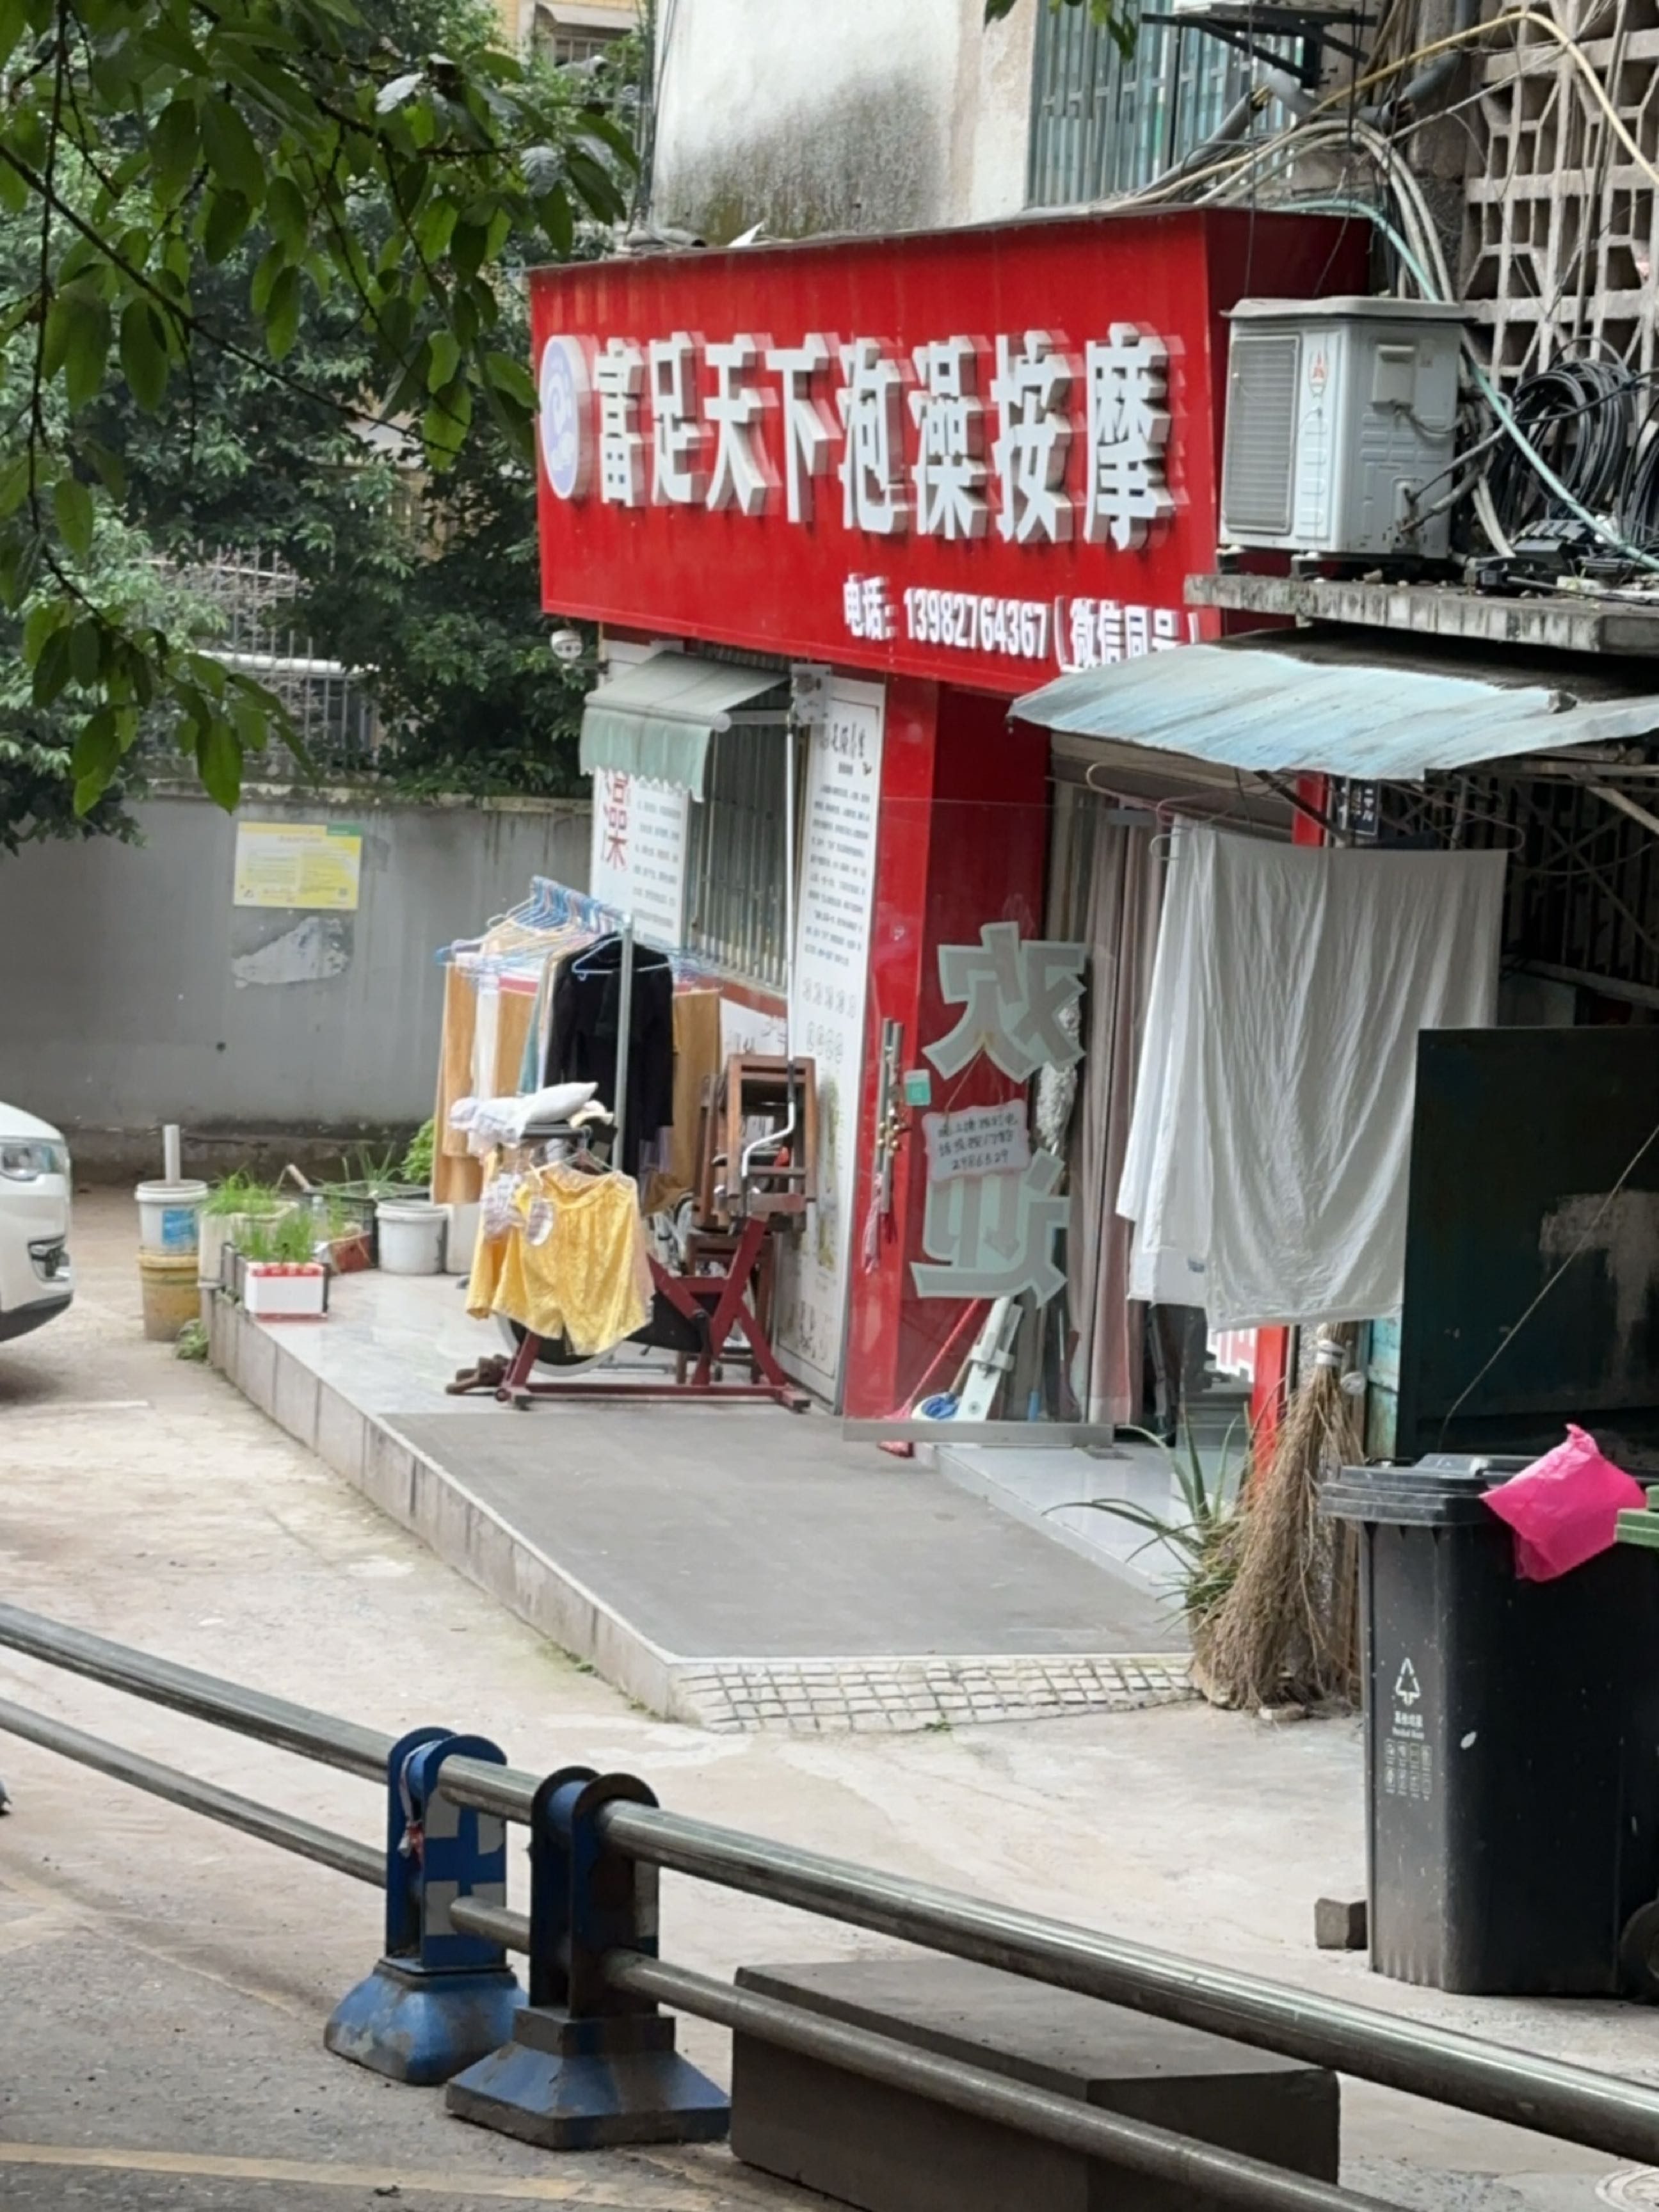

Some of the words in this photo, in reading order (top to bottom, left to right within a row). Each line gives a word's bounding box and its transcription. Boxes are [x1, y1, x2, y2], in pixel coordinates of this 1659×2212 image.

[592, 323, 1173, 549] 富足天下泡澡按摩
[904, 588, 1050, 659] 13982764367
